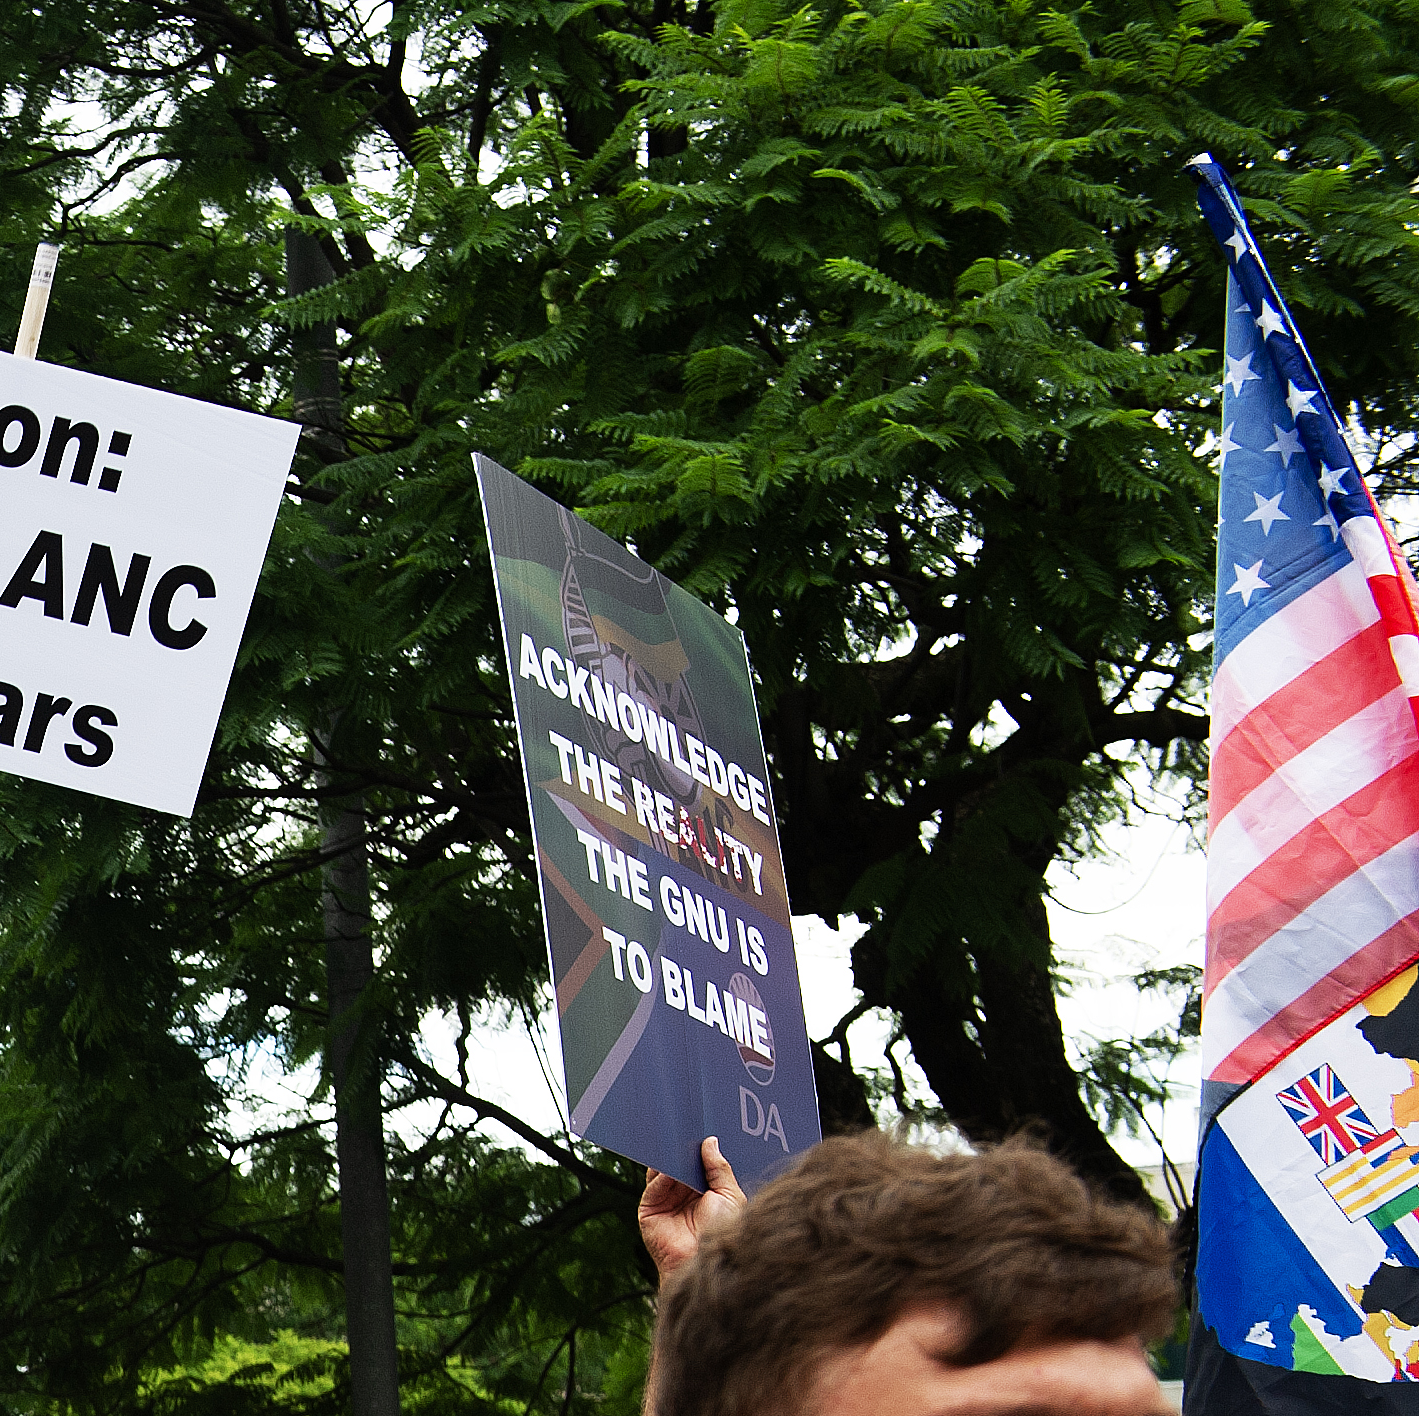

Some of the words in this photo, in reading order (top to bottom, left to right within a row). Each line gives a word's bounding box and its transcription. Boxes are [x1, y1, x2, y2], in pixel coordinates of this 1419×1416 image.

[519, 632, 771, 827] ACKNOWLEDGE
[548, 729, 628, 816] THE
[576, 827, 654, 912] THE
[658, 874, 731, 954] GNU
[735, 916, 770, 977] IS
[601, 925, 653, 994] TO
[660, 954, 772, 1059] BLAME
[738, 1084, 790, 1153] DA
